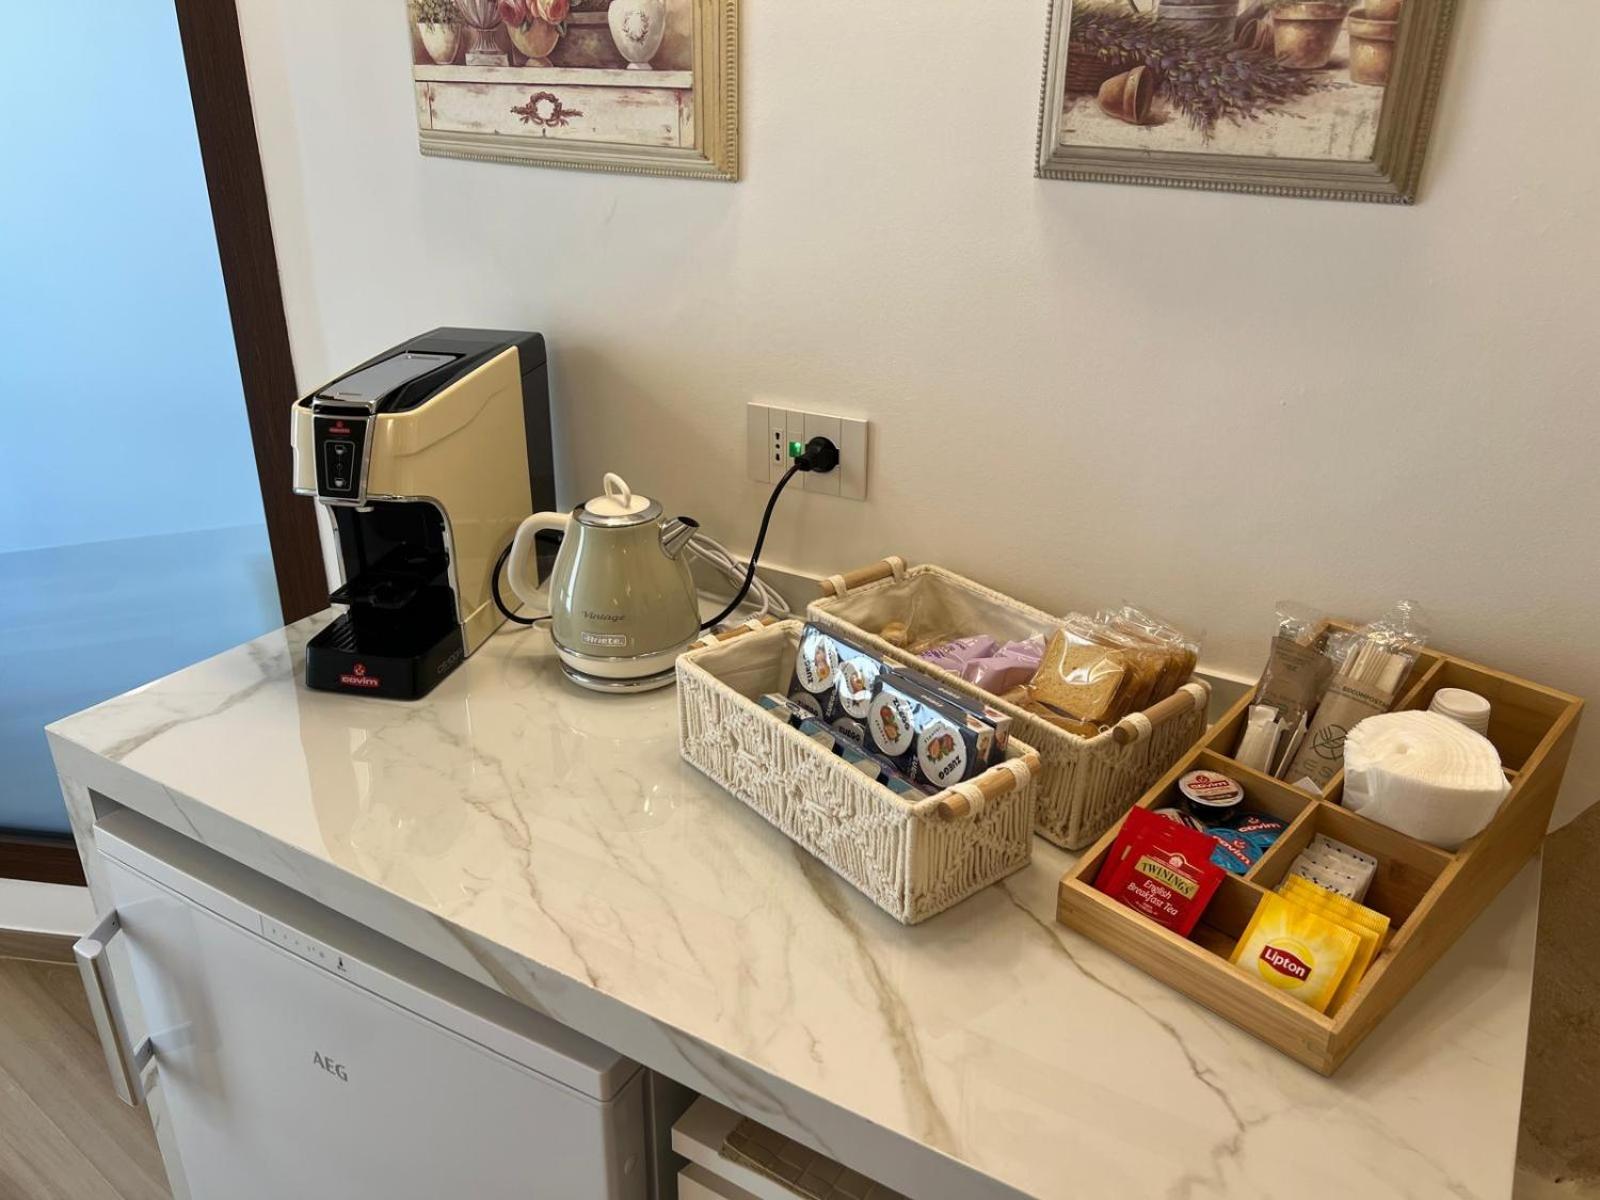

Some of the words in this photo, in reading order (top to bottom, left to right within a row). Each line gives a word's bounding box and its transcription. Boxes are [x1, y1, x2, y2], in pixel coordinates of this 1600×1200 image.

[938, 755, 962, 780] ZUEGG
[1141, 862, 1191, 896] TWININGS
[1143, 879, 1172, 900] English
[1127, 882, 1164, 907] Breakfast
[1163, 901, 1179, 916] Tea
[1264, 948, 1306, 977] Lipton
[313, 1051, 348, 1082] AEG
